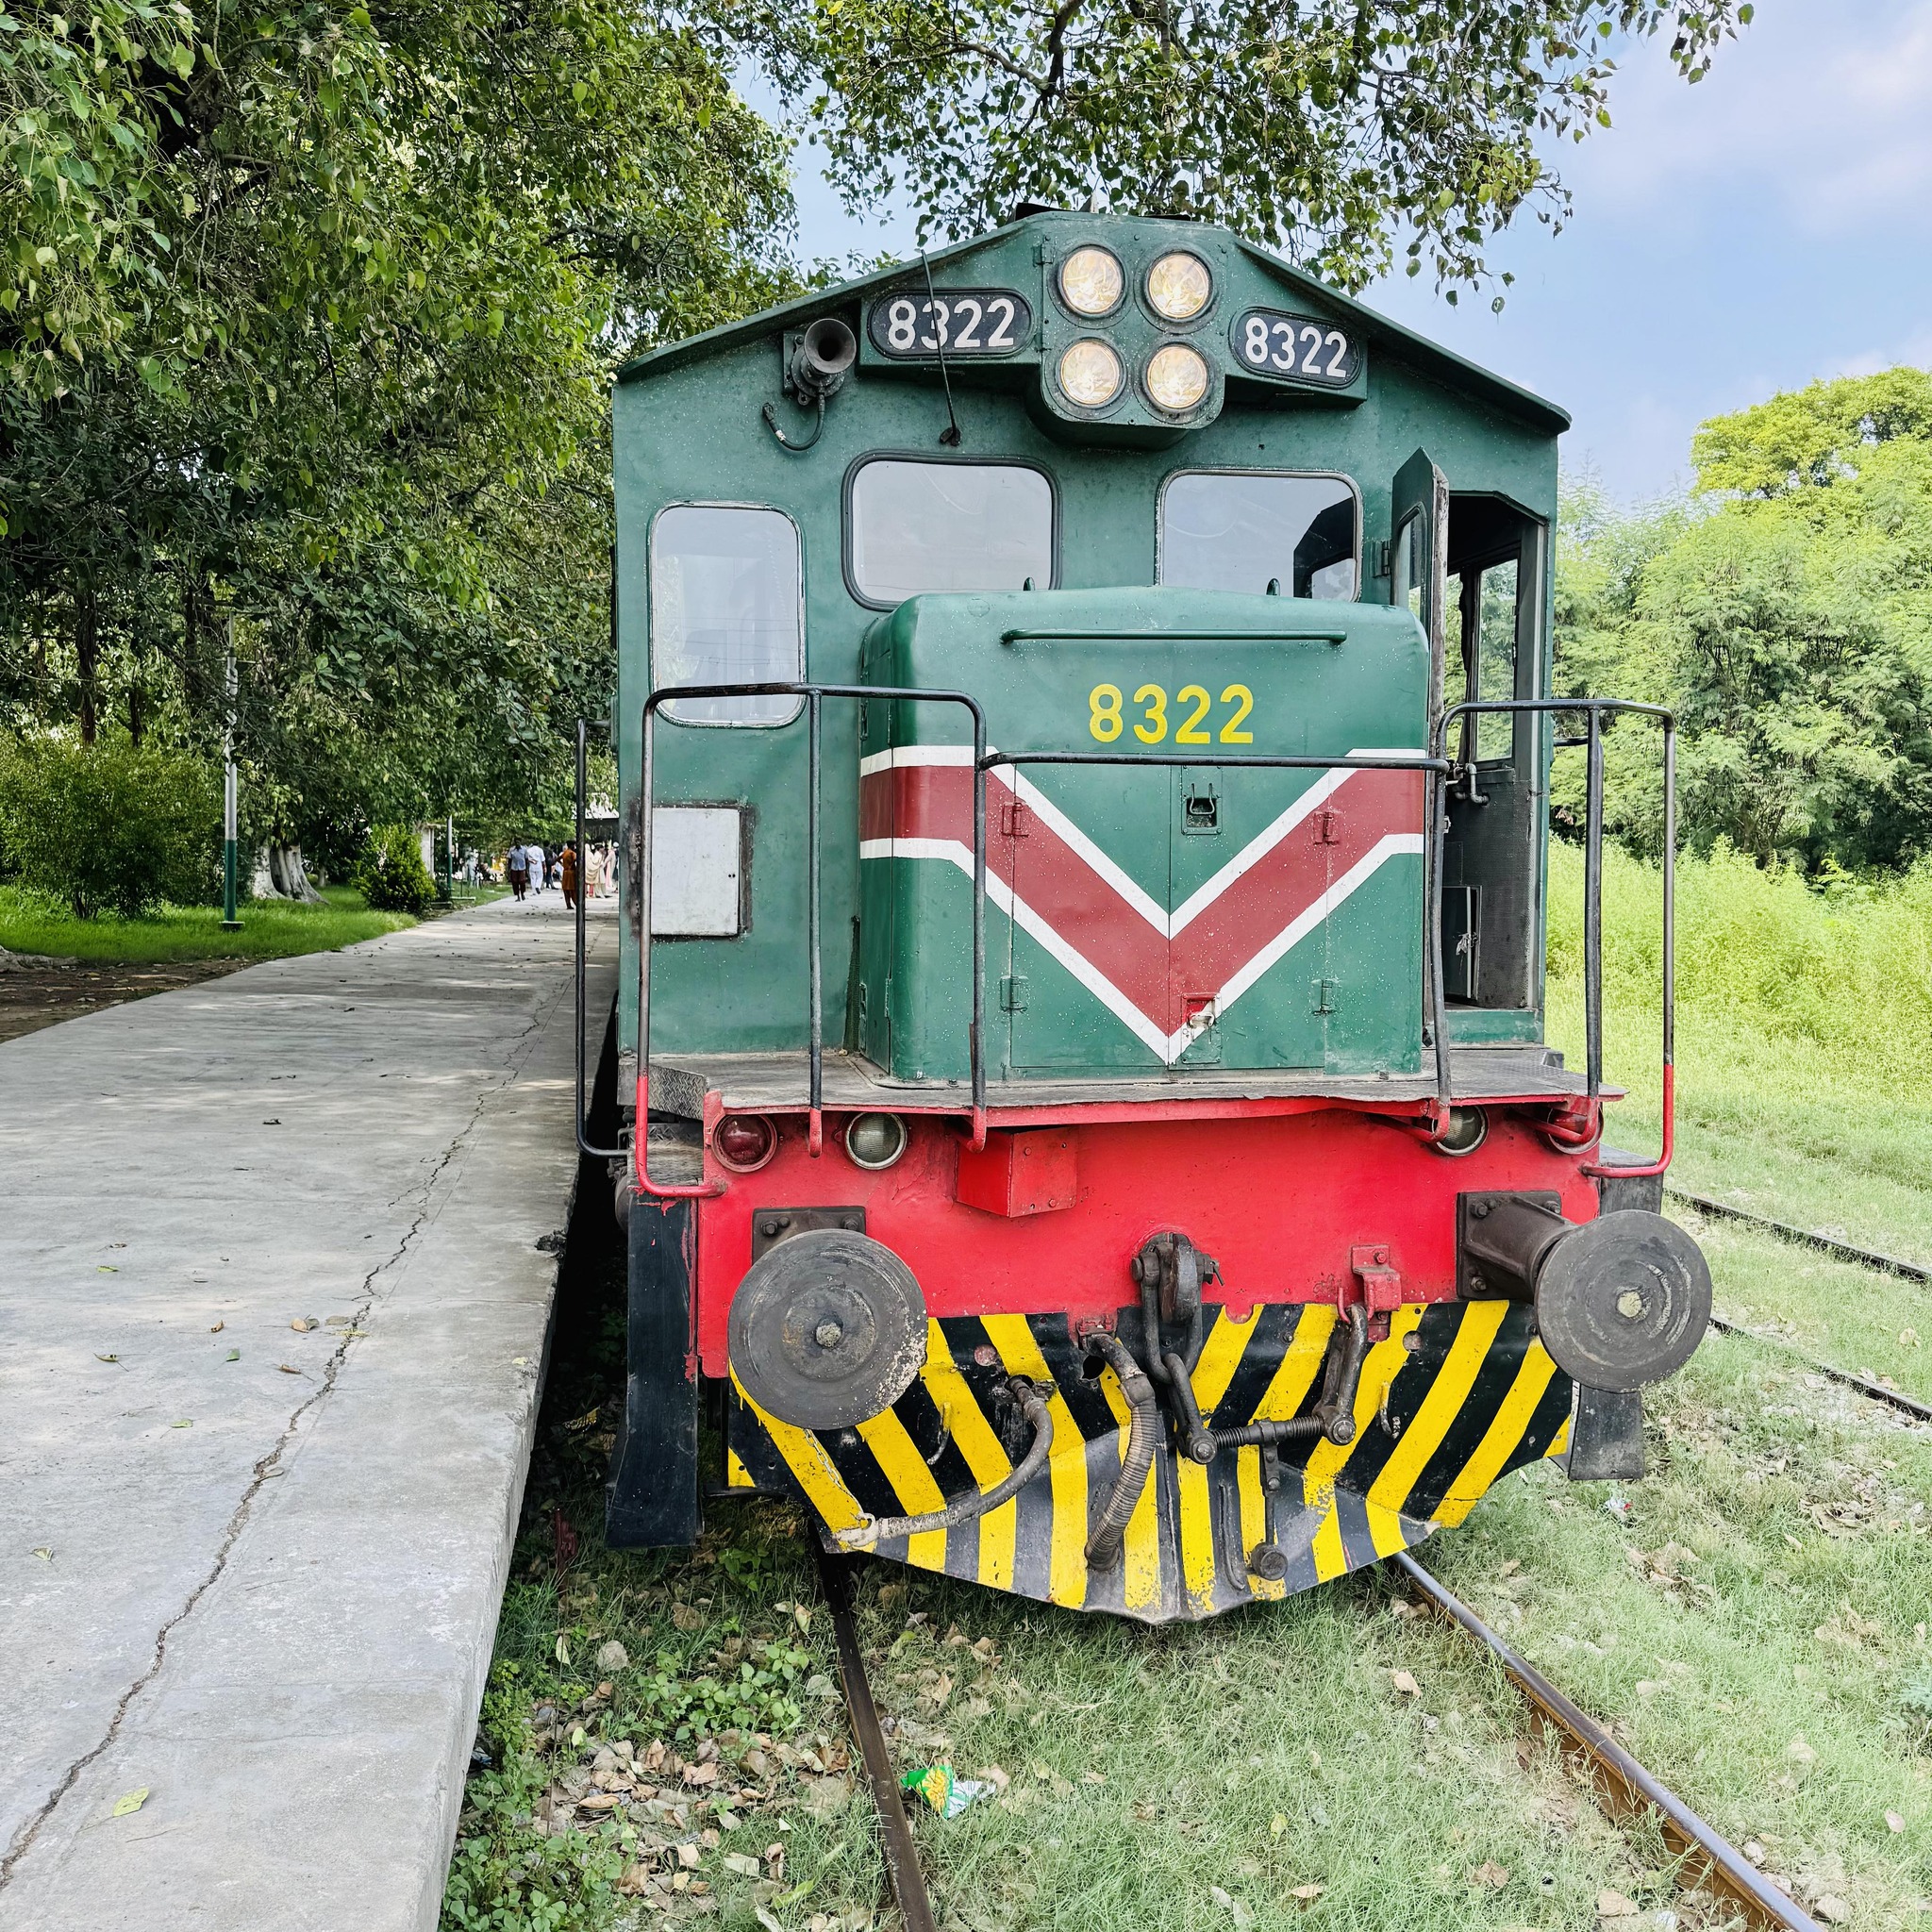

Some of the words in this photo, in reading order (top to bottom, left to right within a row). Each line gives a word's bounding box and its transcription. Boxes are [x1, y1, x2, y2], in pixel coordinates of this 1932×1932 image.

[889, 299, 1015, 350] 8322
[1245, 317, 1347, 377] 8322
[1090, 684, 1254, 743] 8322
